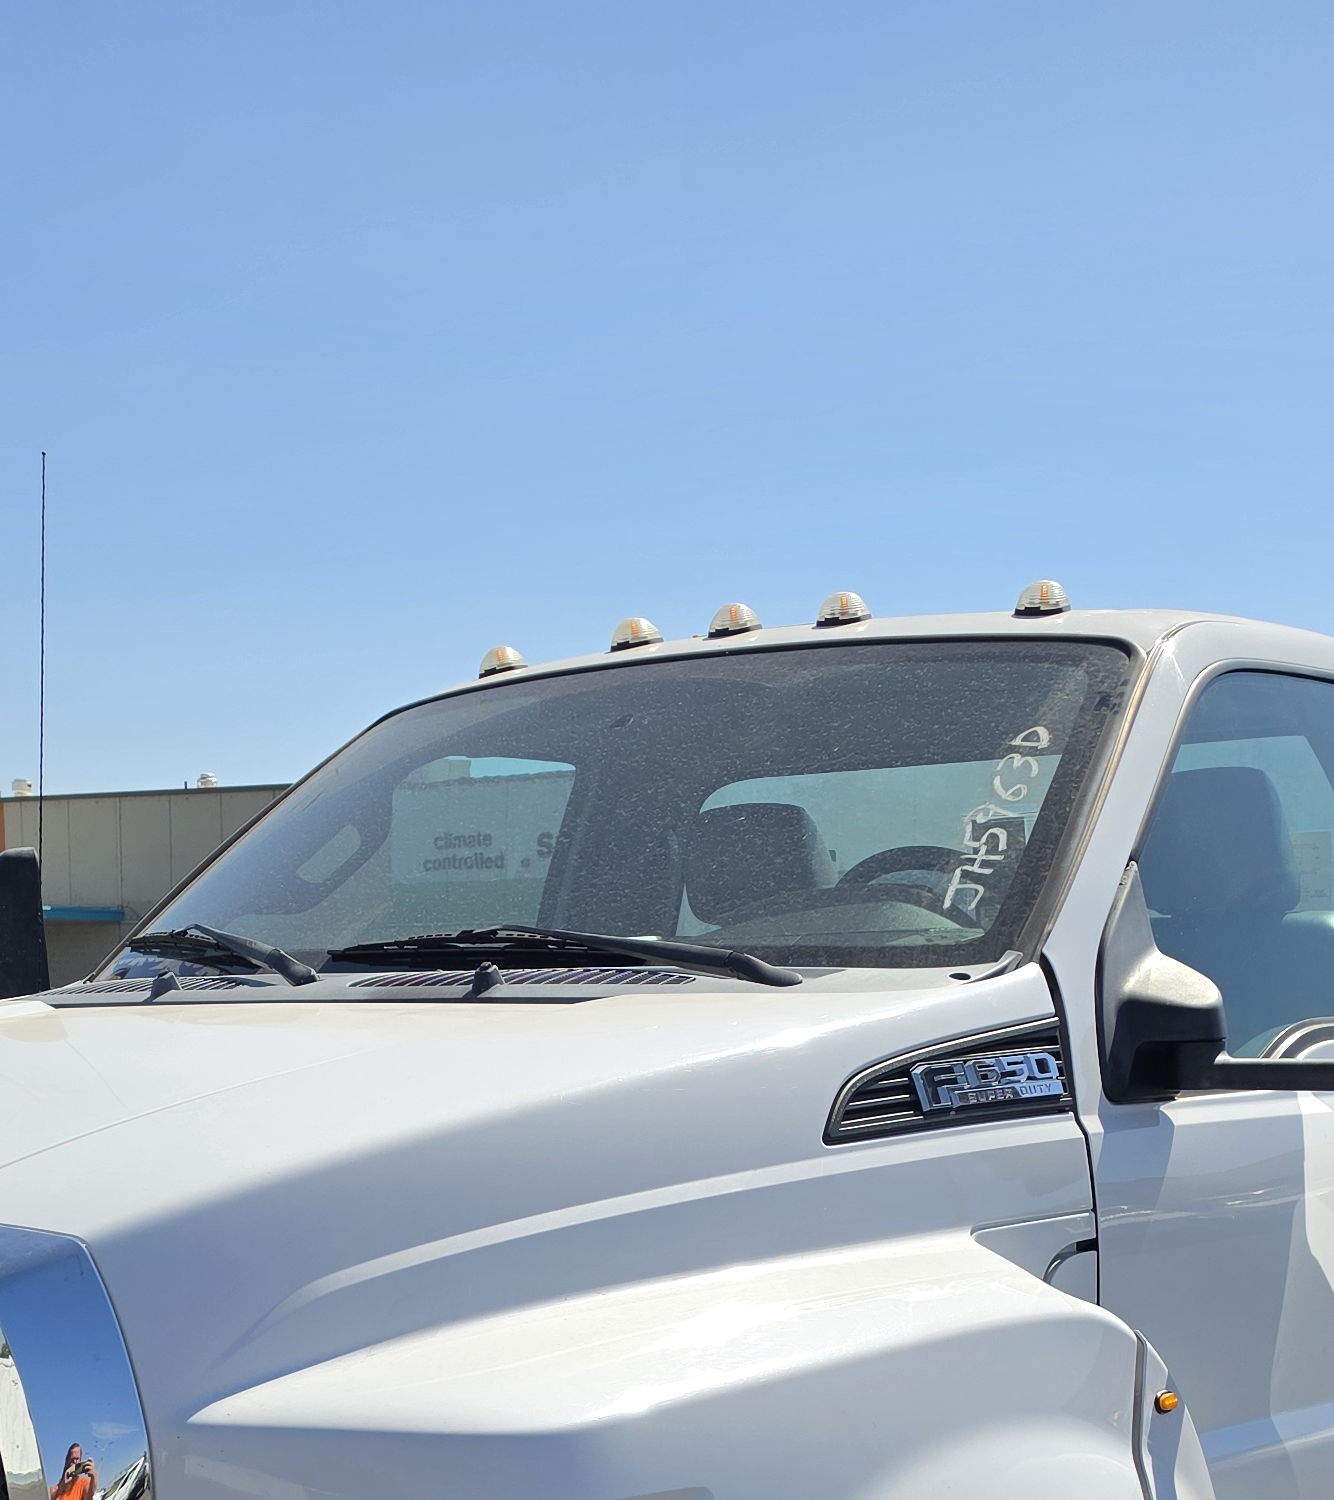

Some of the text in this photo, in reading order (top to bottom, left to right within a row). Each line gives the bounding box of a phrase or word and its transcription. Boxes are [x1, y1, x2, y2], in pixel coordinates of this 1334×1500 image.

[433, 832, 493, 850] climate
[423, 851, 505, 872] controlled
[967, 1083, 1053, 1104] SUPER DUTY
